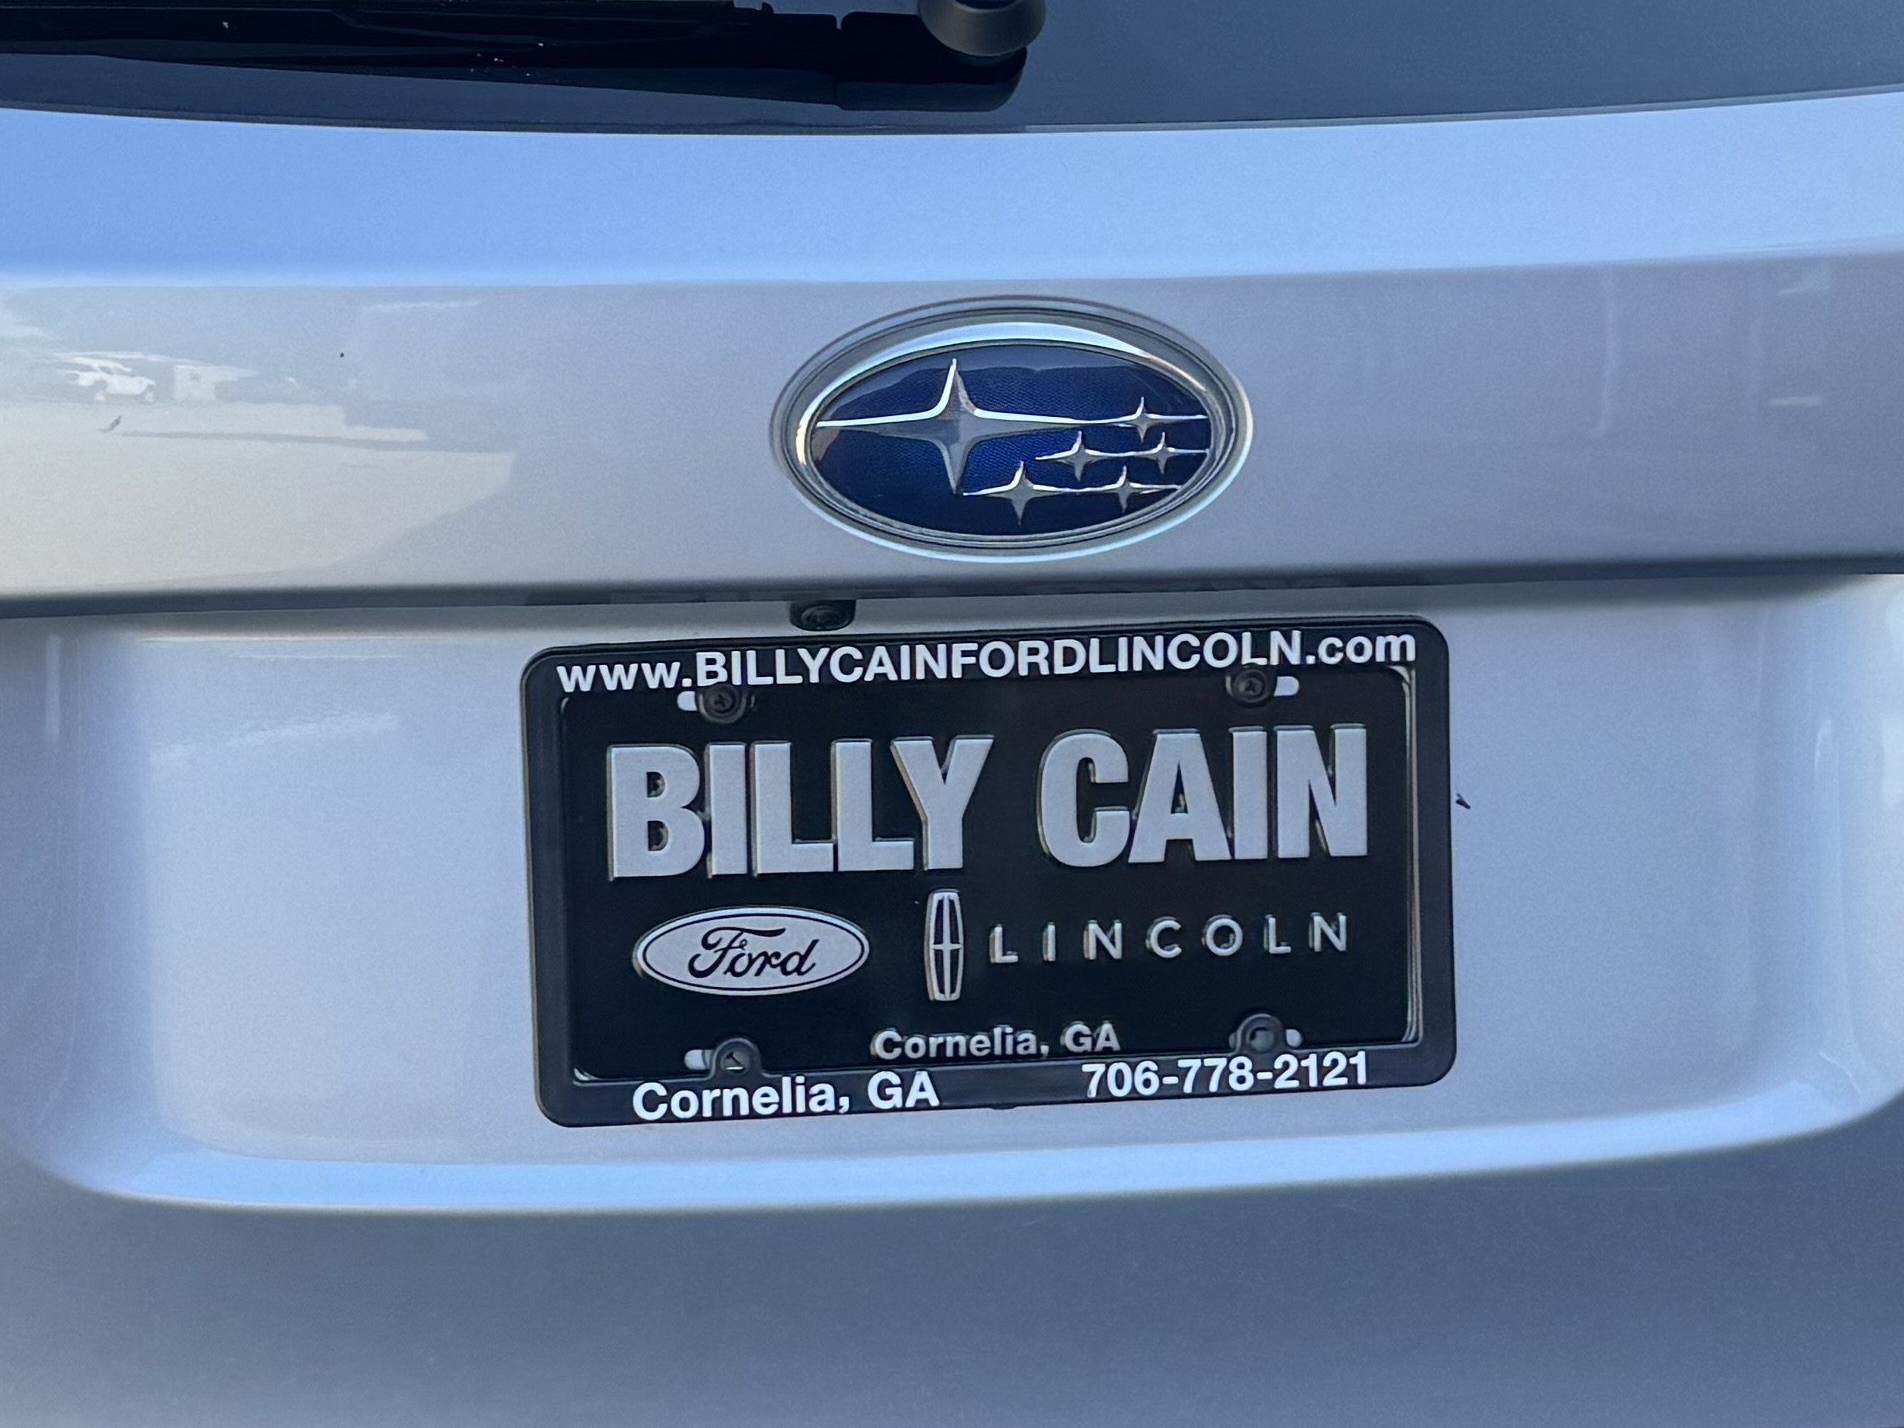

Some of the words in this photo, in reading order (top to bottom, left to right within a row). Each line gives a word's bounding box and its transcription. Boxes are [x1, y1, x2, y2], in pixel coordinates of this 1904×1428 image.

[556, 630, 1417, 693] www.BILLYCAINFORDLINCOLN.com
[607, 735, 993, 881] BILLY
[1037, 724, 1367, 867] CAIN
[688, 926, 820, 978] Ford
[990, 912, 1347, 963] LINCOLN
[871, 1024, 1049, 1060] Cornelia,
[1060, 1020, 1120, 1053] GA
[633, 1075, 850, 1120] Cornelia,
[867, 1070, 940, 1110] GA
[1081, 1051, 1367, 1098] 706-778-2121
